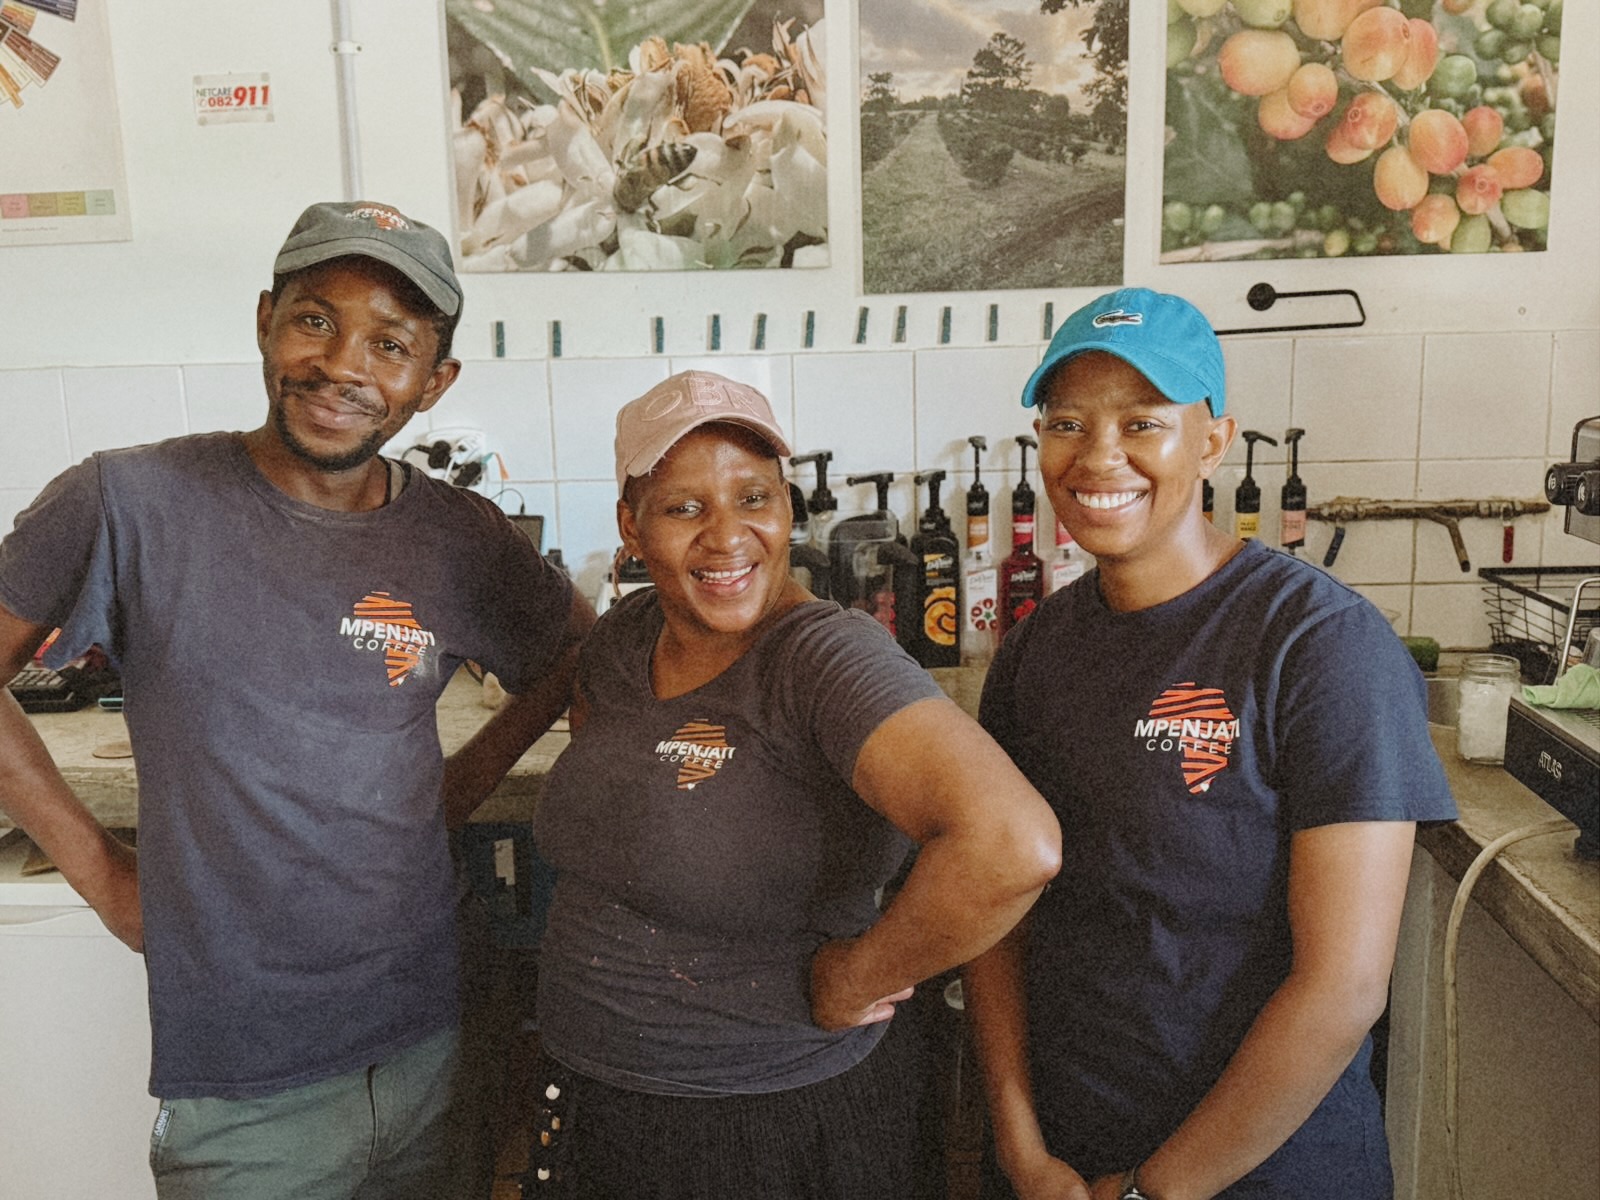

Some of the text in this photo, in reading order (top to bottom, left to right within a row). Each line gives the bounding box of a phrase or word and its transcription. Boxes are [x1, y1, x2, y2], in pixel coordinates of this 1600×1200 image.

[196, 87, 233, 97] NETCARE
[208, 85, 269, 107] 082 911
[339, 617, 436, 647] MPENJATI
[353, 637, 427, 656] COFFEE
[1133, 718, 1241, 740] MPENJATI
[654, 740, 737, 760] MPENJATI
[1145, 738, 1233, 755] COFFEE
[659, 754, 724, 769] COFFEE
[1538, 751, 1563, 780] ATLAS
